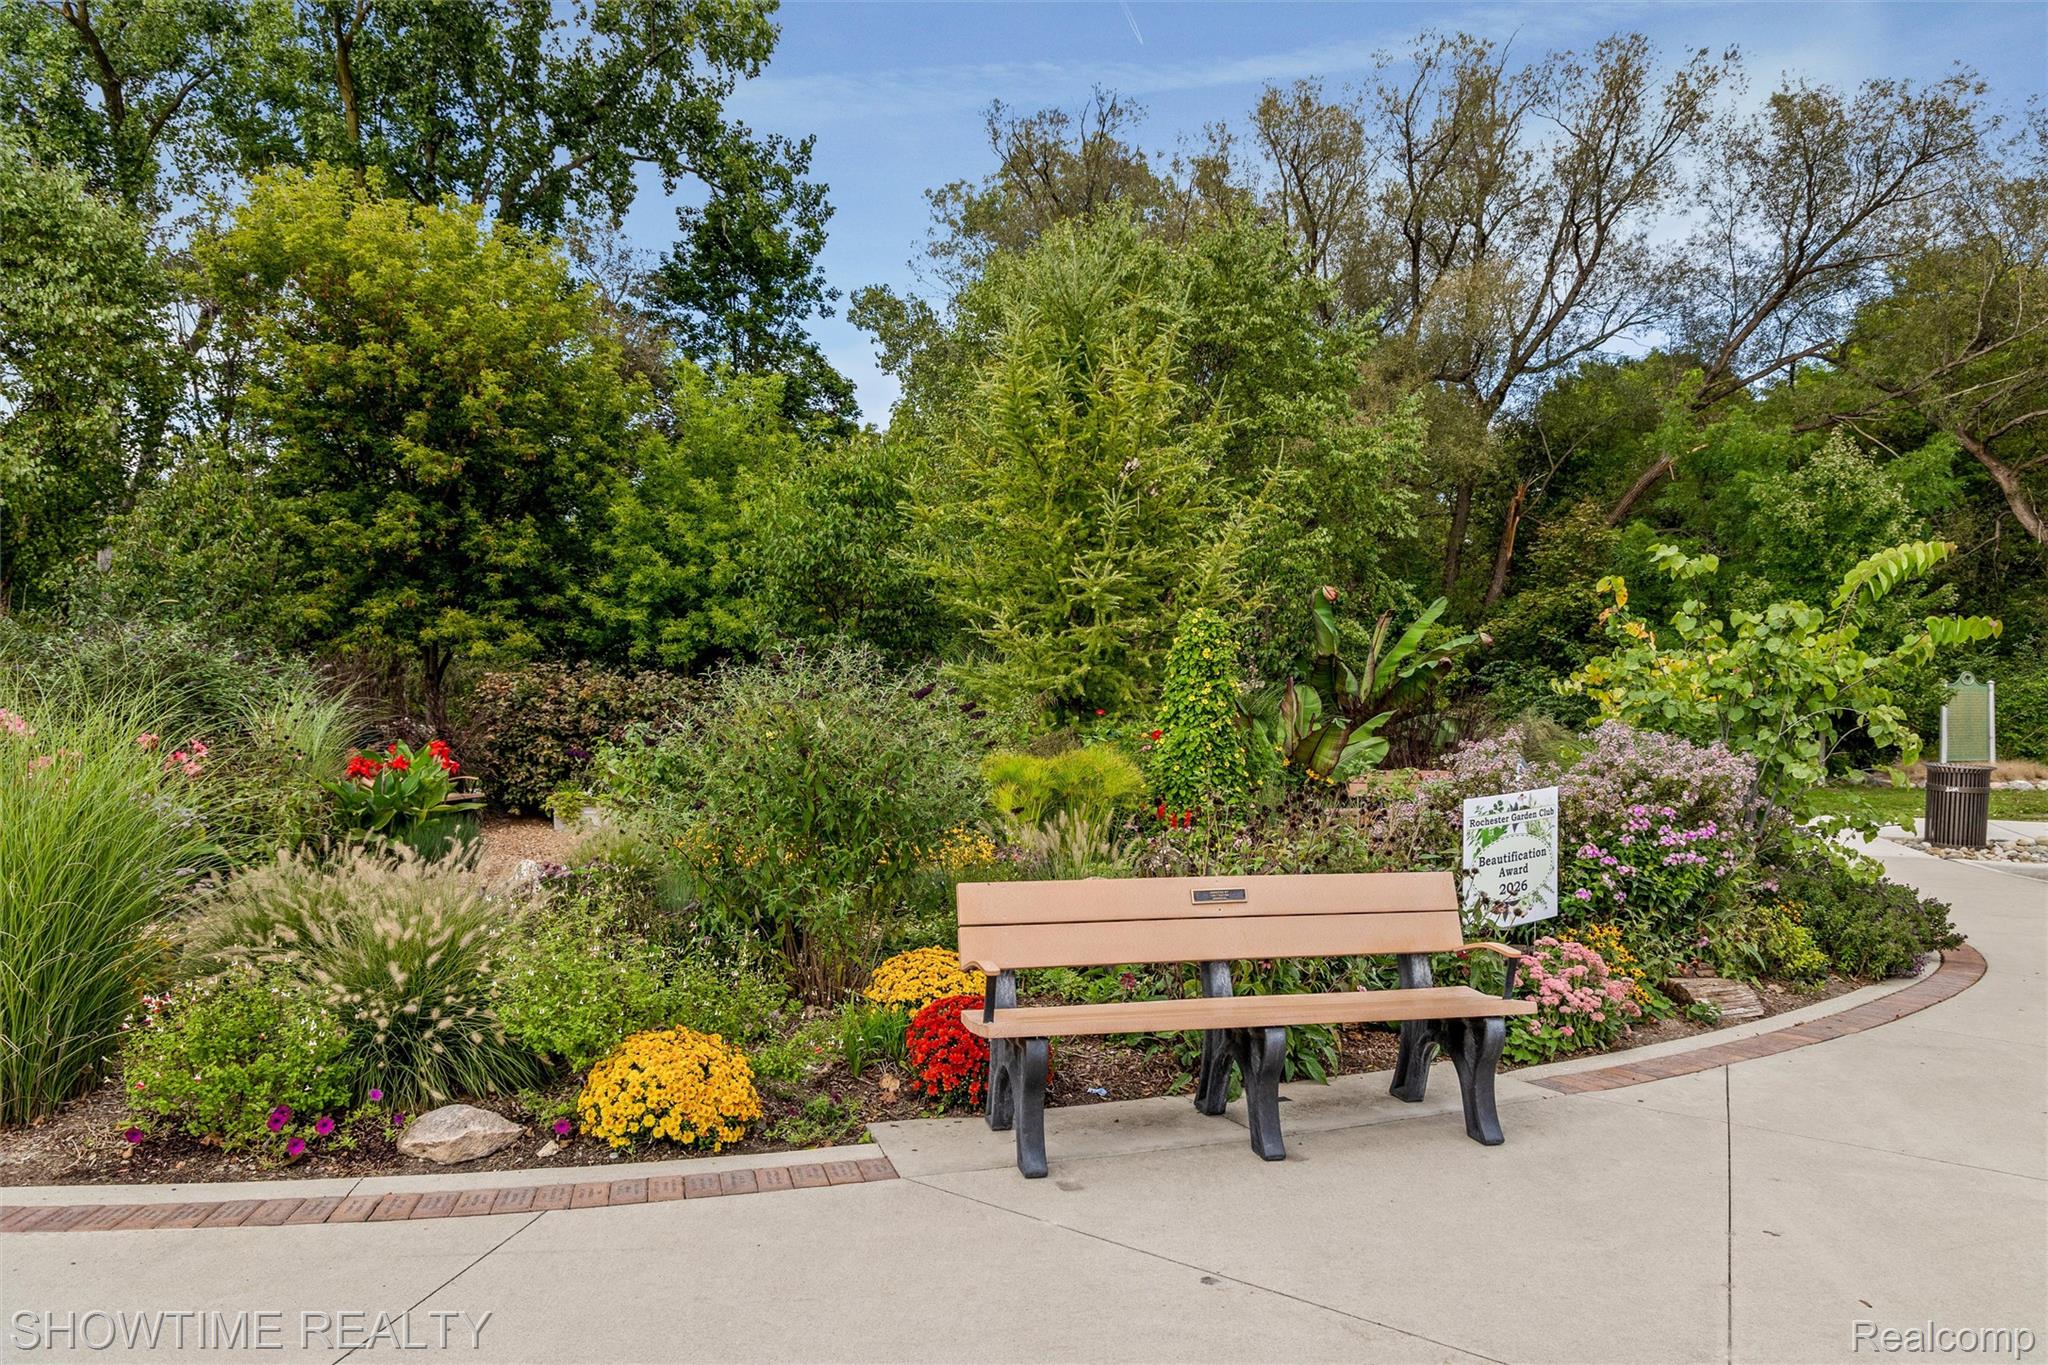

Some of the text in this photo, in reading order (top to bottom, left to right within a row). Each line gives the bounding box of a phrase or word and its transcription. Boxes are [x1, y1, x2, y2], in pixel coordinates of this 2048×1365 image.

[1469, 807, 1554, 828] Rochester Garden Club
[1478, 847, 1547, 867] Beautification
[1498, 863, 1528, 878] Award
[1499, 879, 1528, 895] 2026
